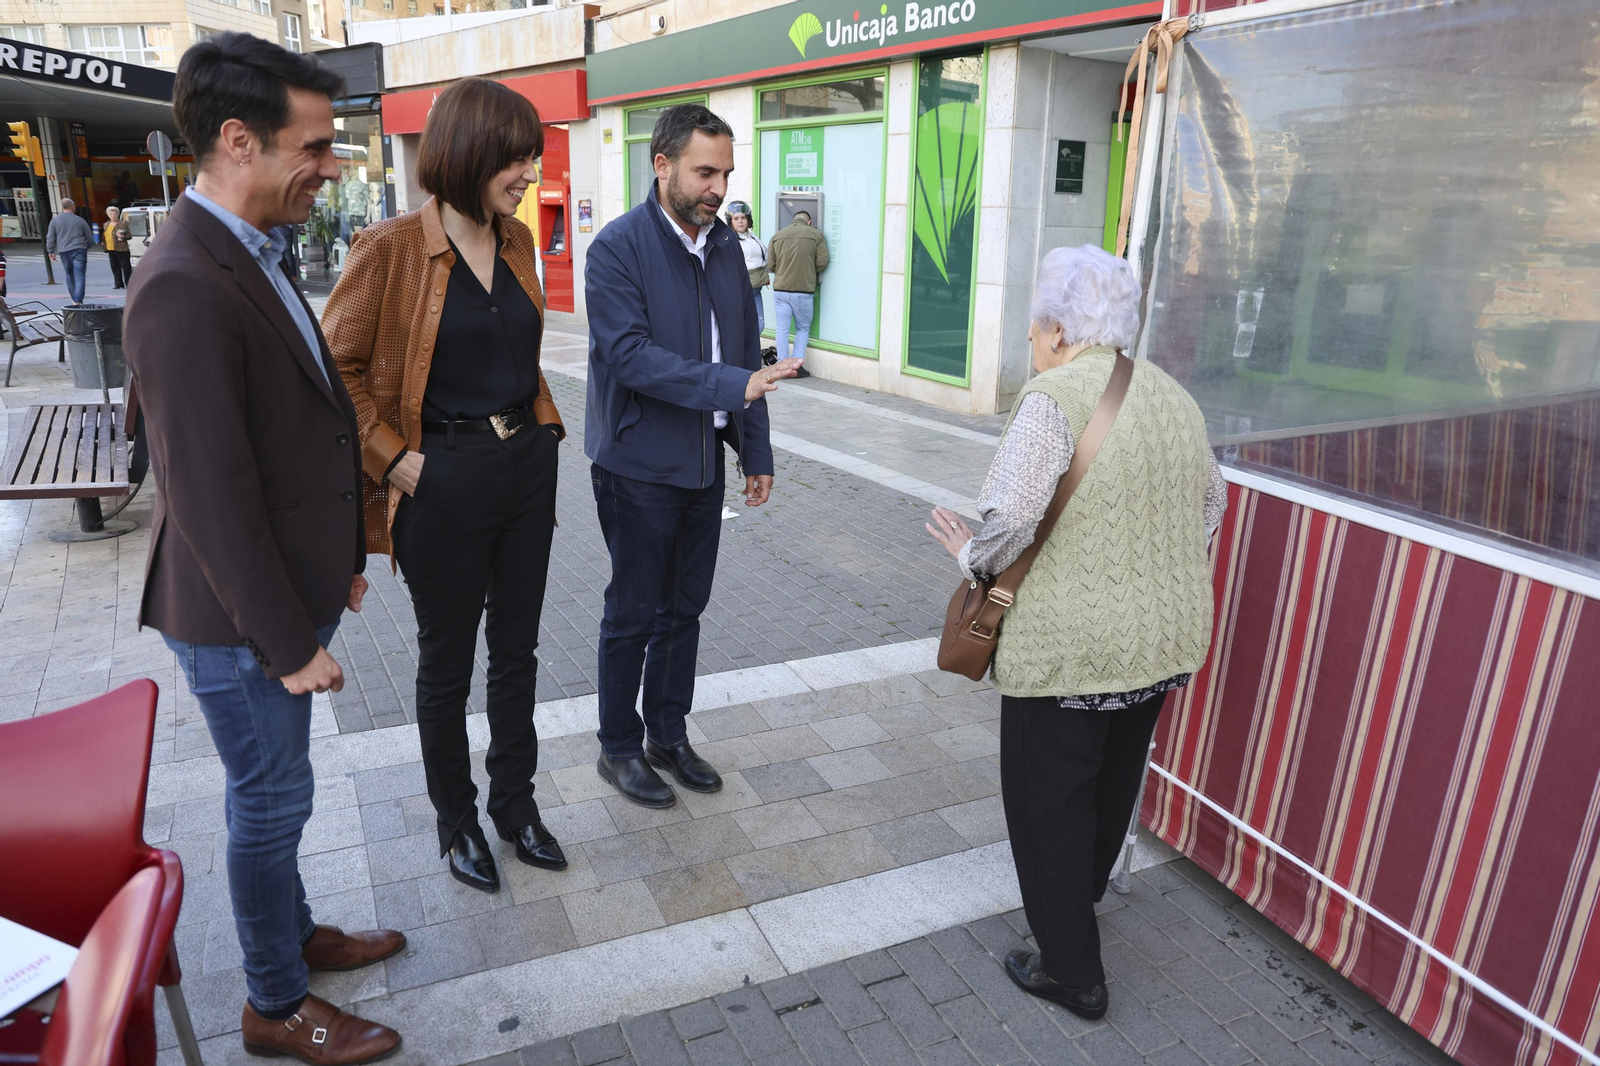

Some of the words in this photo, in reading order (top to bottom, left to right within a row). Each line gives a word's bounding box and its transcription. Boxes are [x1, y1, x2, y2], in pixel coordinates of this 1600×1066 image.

[825, 3, 898, 47] Unicaja
[905, 0, 976, 33] Banco
[0, 44, 126, 88] REPSOL
[791, 130, 804, 145] ATM
